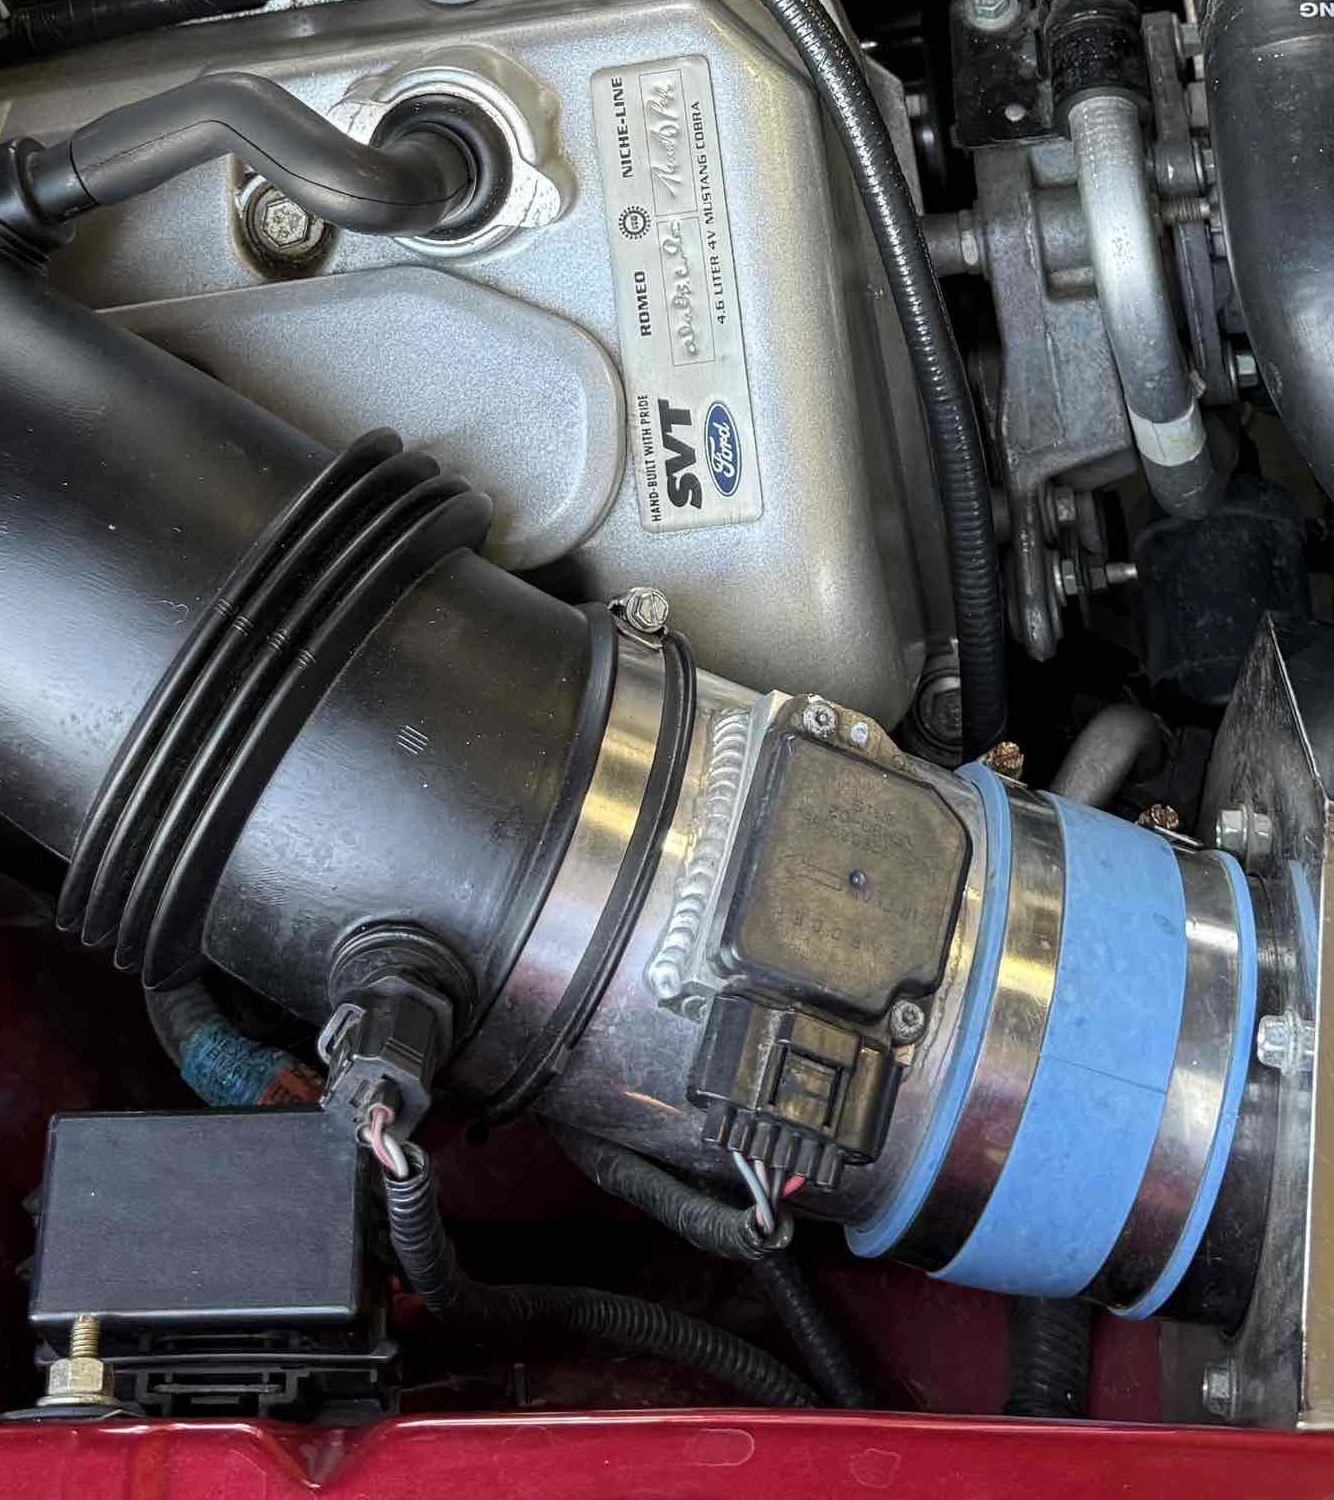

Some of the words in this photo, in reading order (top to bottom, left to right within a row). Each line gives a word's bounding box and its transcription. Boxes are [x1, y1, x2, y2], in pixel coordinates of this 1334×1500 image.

[610, 76, 635, 179] NICHE-LINE
[690, 101, 706, 150] COBRA
[696, 154, 715, 225] MUSTANG
[706, 230, 718, 251] 4V
[709, 255, 724, 295] LITER
[633, 270, 653, 337] ROMEO
[714, 300, 727, 325] 4.6
[636, 394, 651, 425] PRIDE
[640, 428, 654, 456] WITH
[655, 394, 704, 513] SVT
[643, 458, 662, 523] HAND-BUILT
